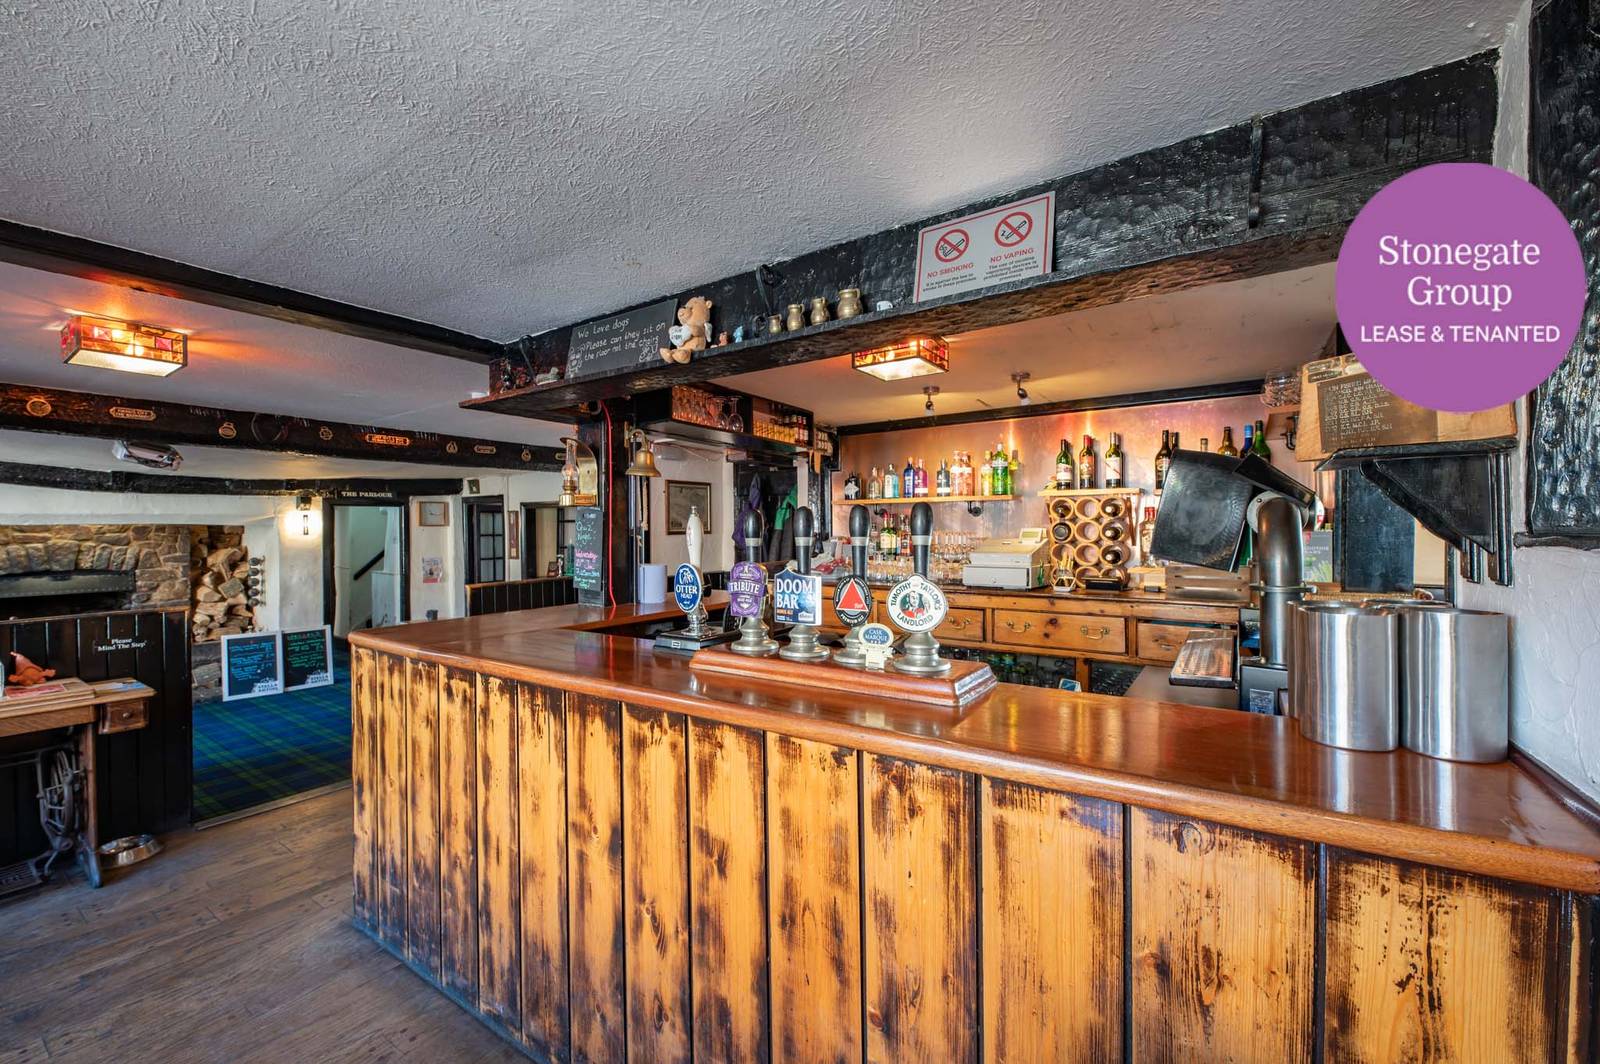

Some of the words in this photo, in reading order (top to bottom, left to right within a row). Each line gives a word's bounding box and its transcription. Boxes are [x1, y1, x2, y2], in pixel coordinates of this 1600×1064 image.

[1004, 248, 1034, 260] VAPING
[939, 262, 974, 275] SMOKING
[578, 330, 589, 338] We
[612, 318, 630, 332] dogs
[586, 340, 607, 350] Please
[625, 331, 640, 342] they
[642, 326, 653, 334] sit
[656, 322, 666, 331] on
[625, 342, 636, 350] the
[638, 335, 659, 346] chairs
[676, 584, 698, 594] OTTER
[729, 582, 760, 593] TRIBUTE
[777, 578, 813, 594] DOOM
[891, 581, 911, 606] TIMOTHY
[777, 594, 799, 609] BAR
[897, 612, 933, 627] LANDLORD
